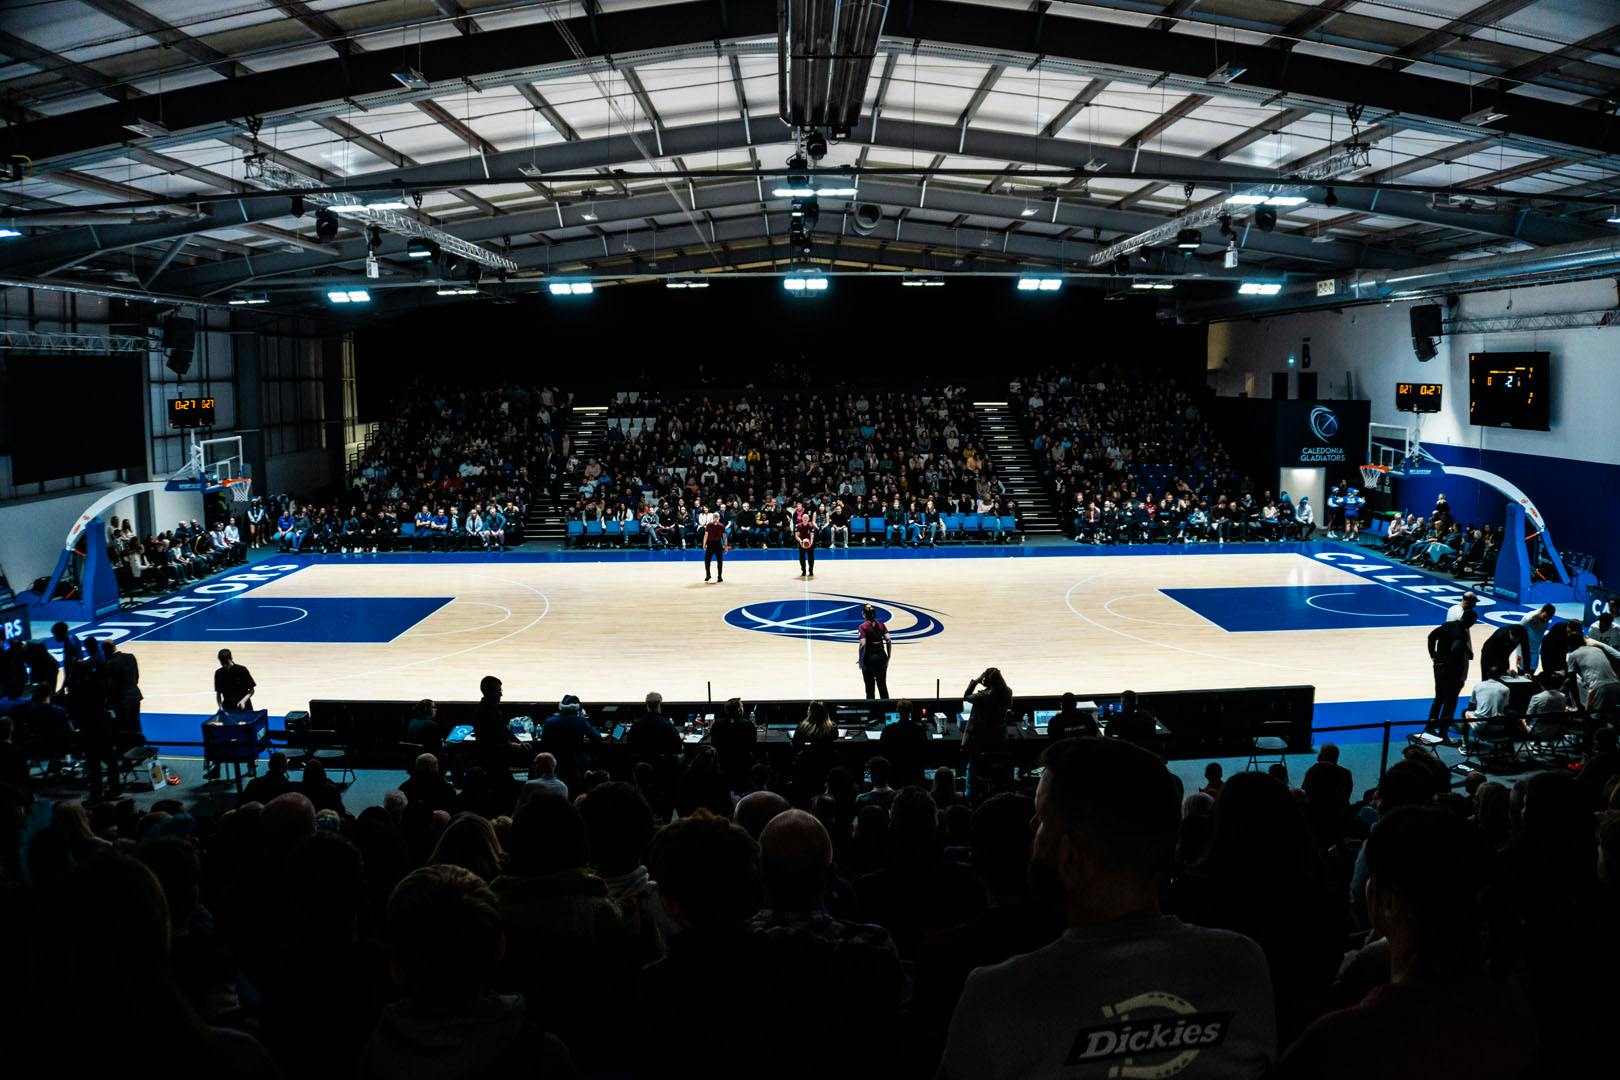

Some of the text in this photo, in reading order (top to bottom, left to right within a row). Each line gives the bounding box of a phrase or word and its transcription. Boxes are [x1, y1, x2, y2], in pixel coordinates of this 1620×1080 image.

[1302, 447, 1344, 455] CALEDONIA
[1300, 454, 1346, 462] GLADIATORS
[1079, 1021, 1221, 1060] Dickies
